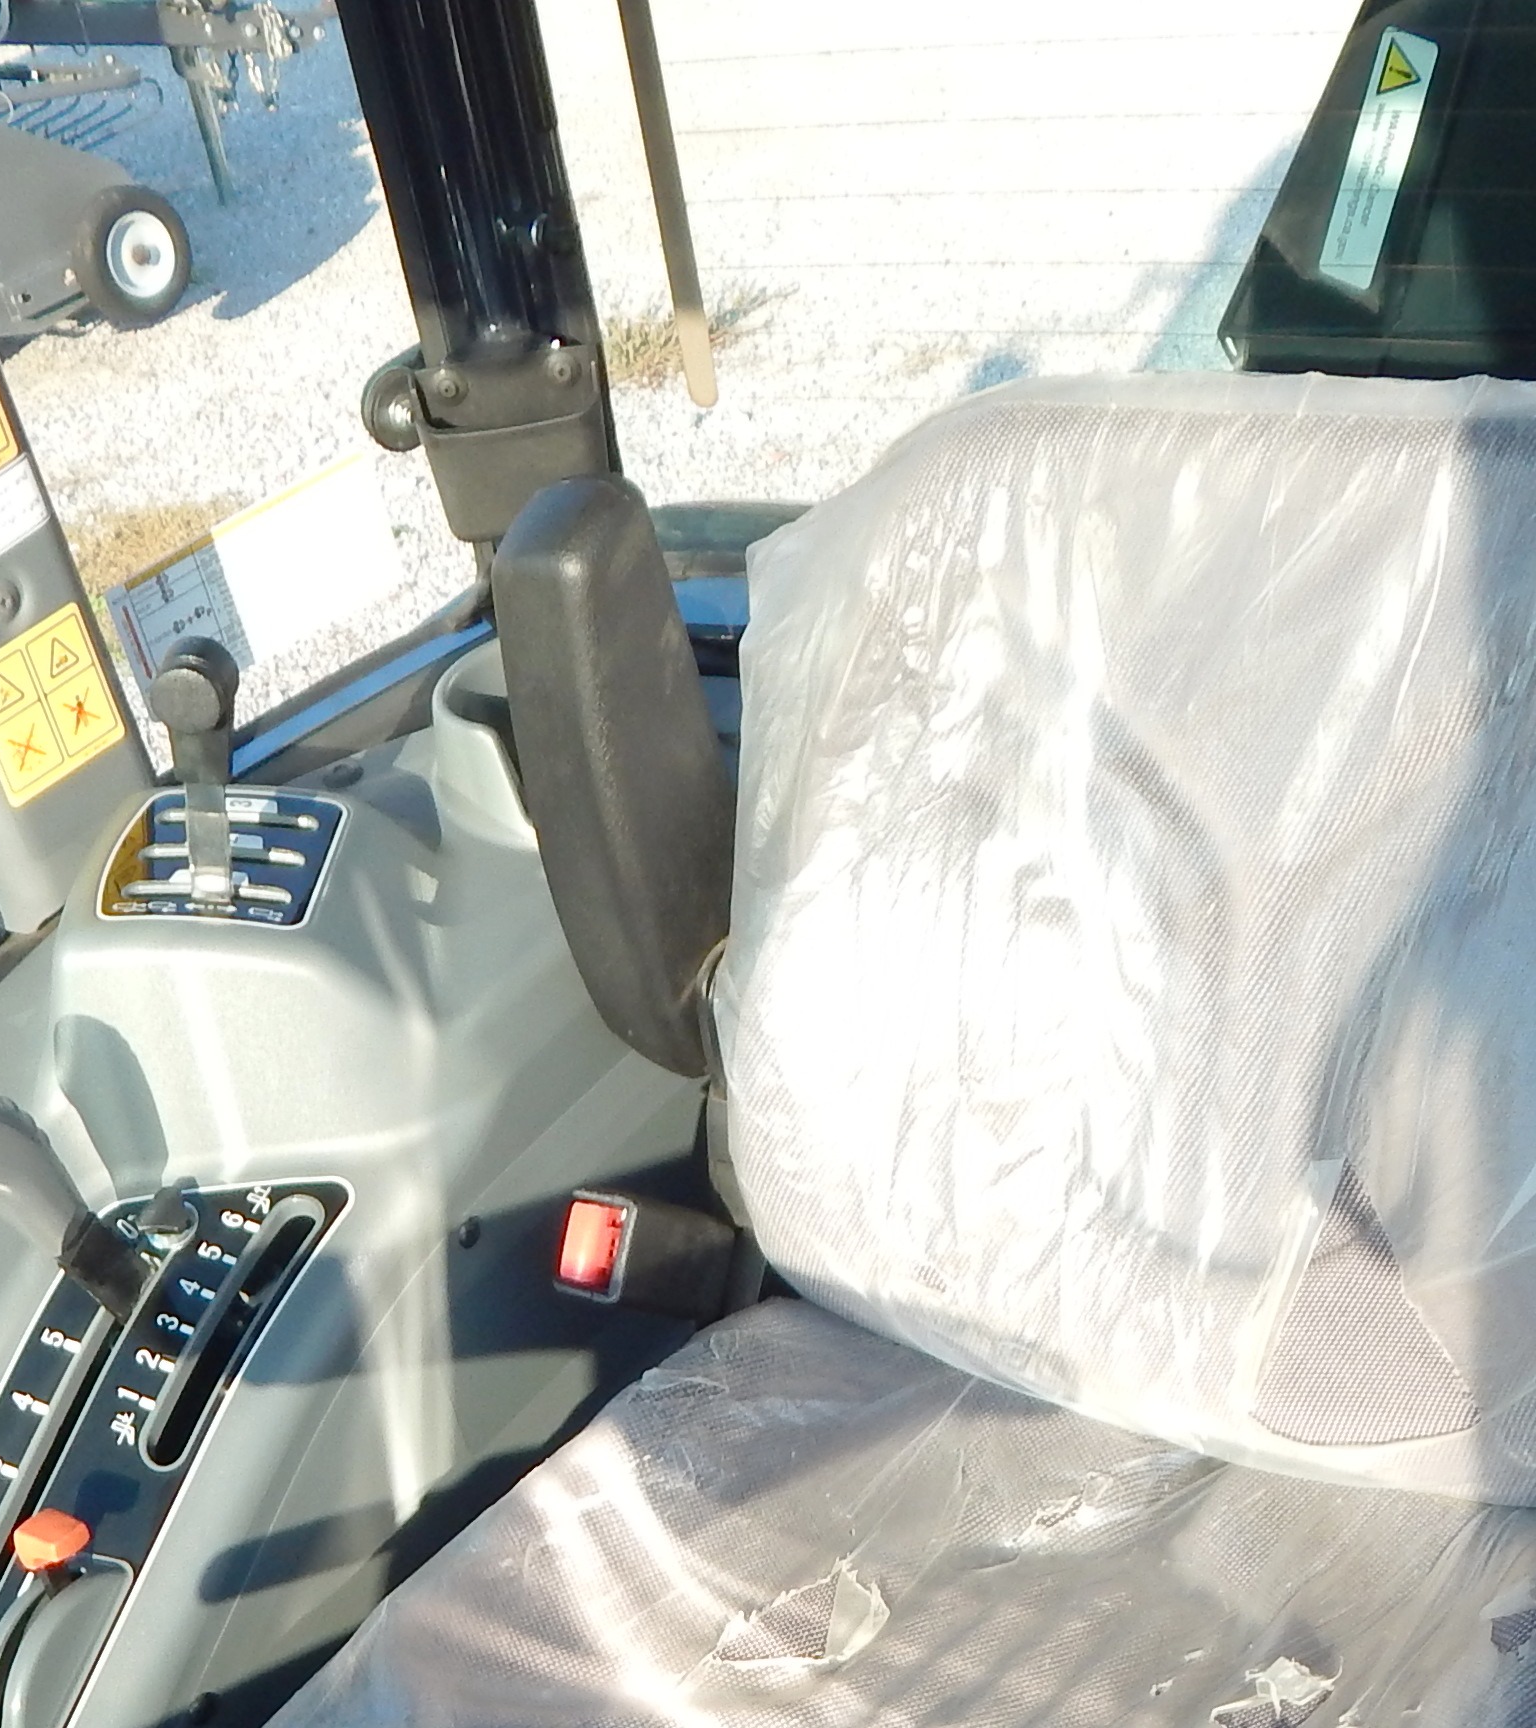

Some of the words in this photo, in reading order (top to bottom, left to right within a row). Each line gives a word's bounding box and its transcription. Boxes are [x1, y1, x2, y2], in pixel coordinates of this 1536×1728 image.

[220, 1210, 244, 1228] 6
[197, 1241, 222, 1261] 5
[179, 1278, 201, 1296] 4
[156, 1313, 179, 1331] 3
[40, 1327, 65, 1348] 5
[135, 1349, 161, 1370] 2
[11, 1391, 34, 1411] 4
[117, 1385, 140, 1401] 1
